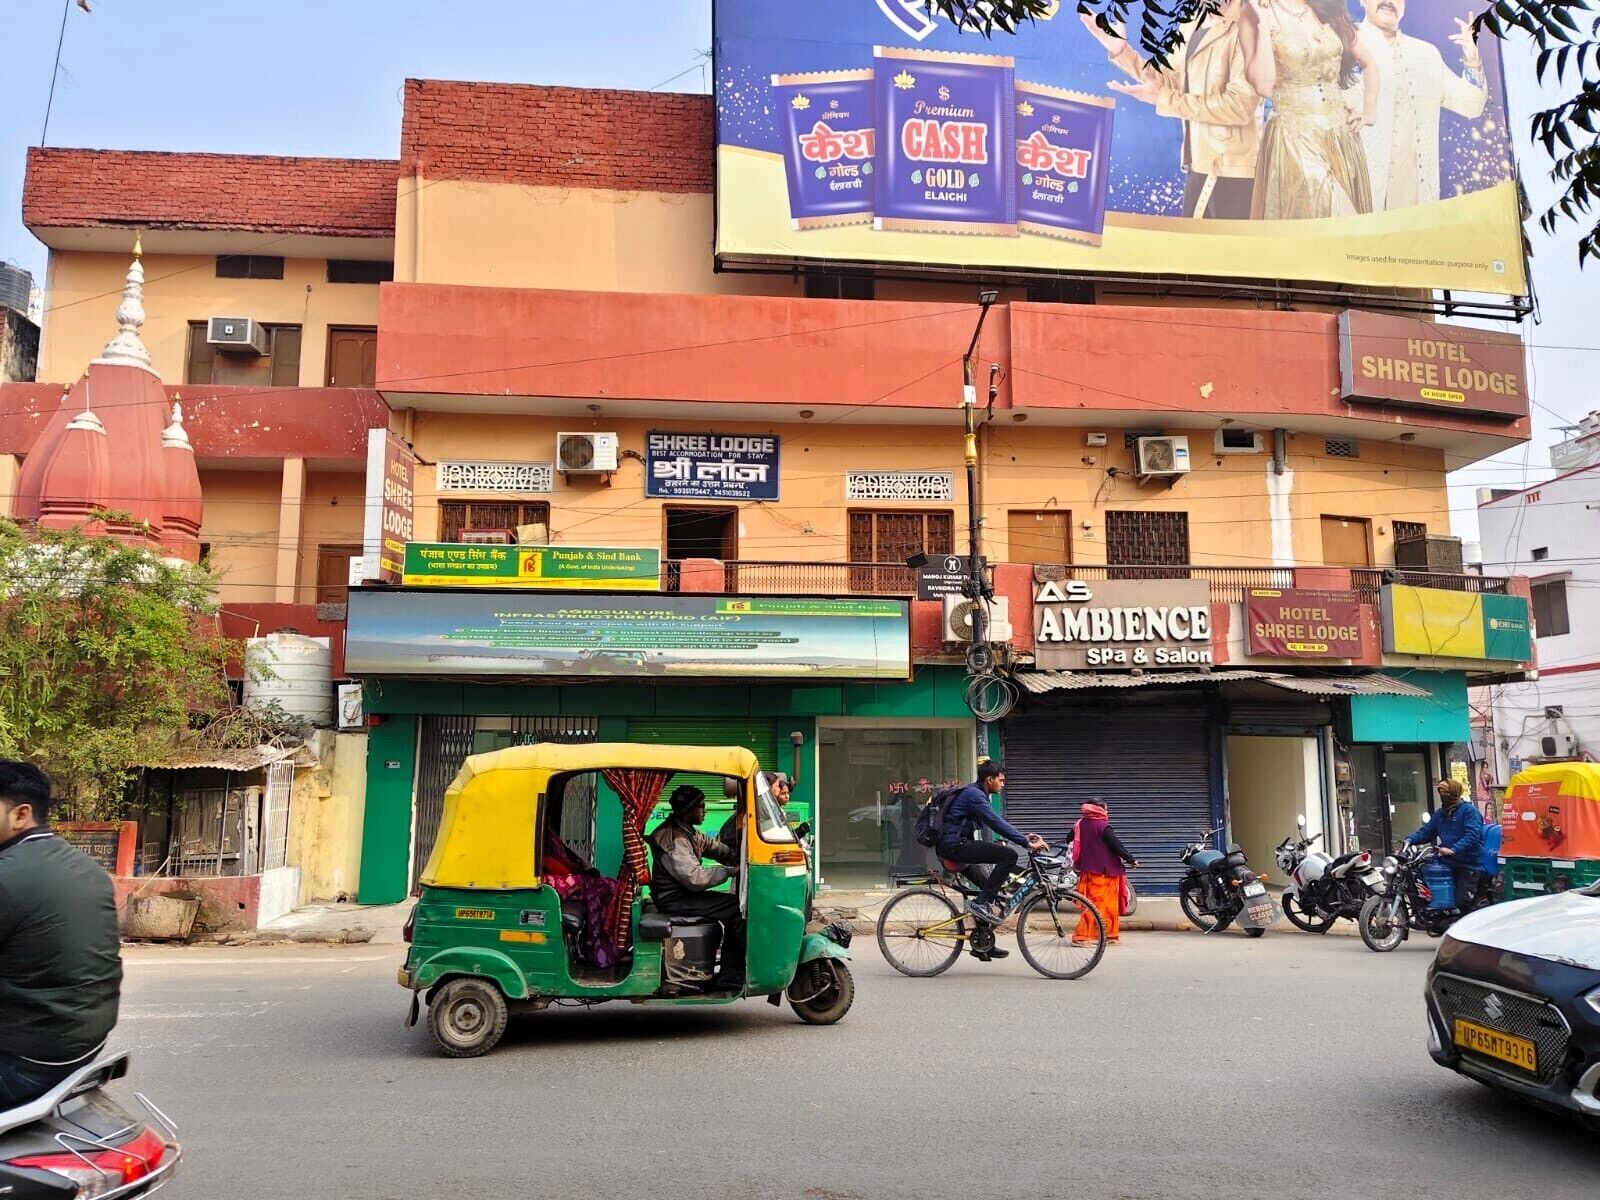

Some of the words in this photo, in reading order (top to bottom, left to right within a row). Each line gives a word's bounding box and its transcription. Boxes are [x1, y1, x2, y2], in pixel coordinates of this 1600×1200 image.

[914, 100, 975, 118] Premium
[799, 120, 875, 162] कैश
[902, 118, 987, 164] CASH
[1016, 130, 1092, 179] कैश
[828, 162, 859, 177] गोल्ड
[925, 168, 965, 189] GOLD
[1034, 174, 1065, 191] गोल्ड
[925, 191, 967, 202] ELAICHI
[1346, 253, 1370, 263] Images
[1371, 255, 1387, 263] used
[1388, 255, 1398, 263] for
[1398, 257, 1446, 266] representation
[1447, 260, 1473, 269] purpose
[1474, 262, 1488, 270] only
[1407, 338, 1471, 363] HOTEL
[1361, 355, 1439, 386] SHREE
[1445, 366, 1519, 396] LODGE
[650, 435, 707, 451] SHREE
[710, 437, 774, 453] LODGE
[669, 451, 723, 459] ACCOMMODATION
[390, 459, 408, 483] HOTEL
[653, 457, 692, 480] श्री
[385, 478, 412, 512] SHREE
[384, 507, 412, 540] LODGE
[420, 548, 445, 559] पंजाब
[447, 549, 466, 561] एण्ड
[490, 548, 507, 560] बैंक
[553, 551, 584, 561] Punjab
[586, 551, 594, 560] &
[596, 551, 616, 560] Sind
[619, 552, 641, 561] Bank
[1035, 580, 1093, 602] AS
[1038, 606, 1210, 642] AMBIENCE
[1280, 607, 1332, 621] HOTEL
[1255, 623, 1305, 639] SHREE
[1309, 625, 1359, 641] LODGE
[1133, 647, 1149, 665] &
[1155, 647, 1212, 665] Salon
[1463, 1026, 1533, 1065] UP65MT9316
